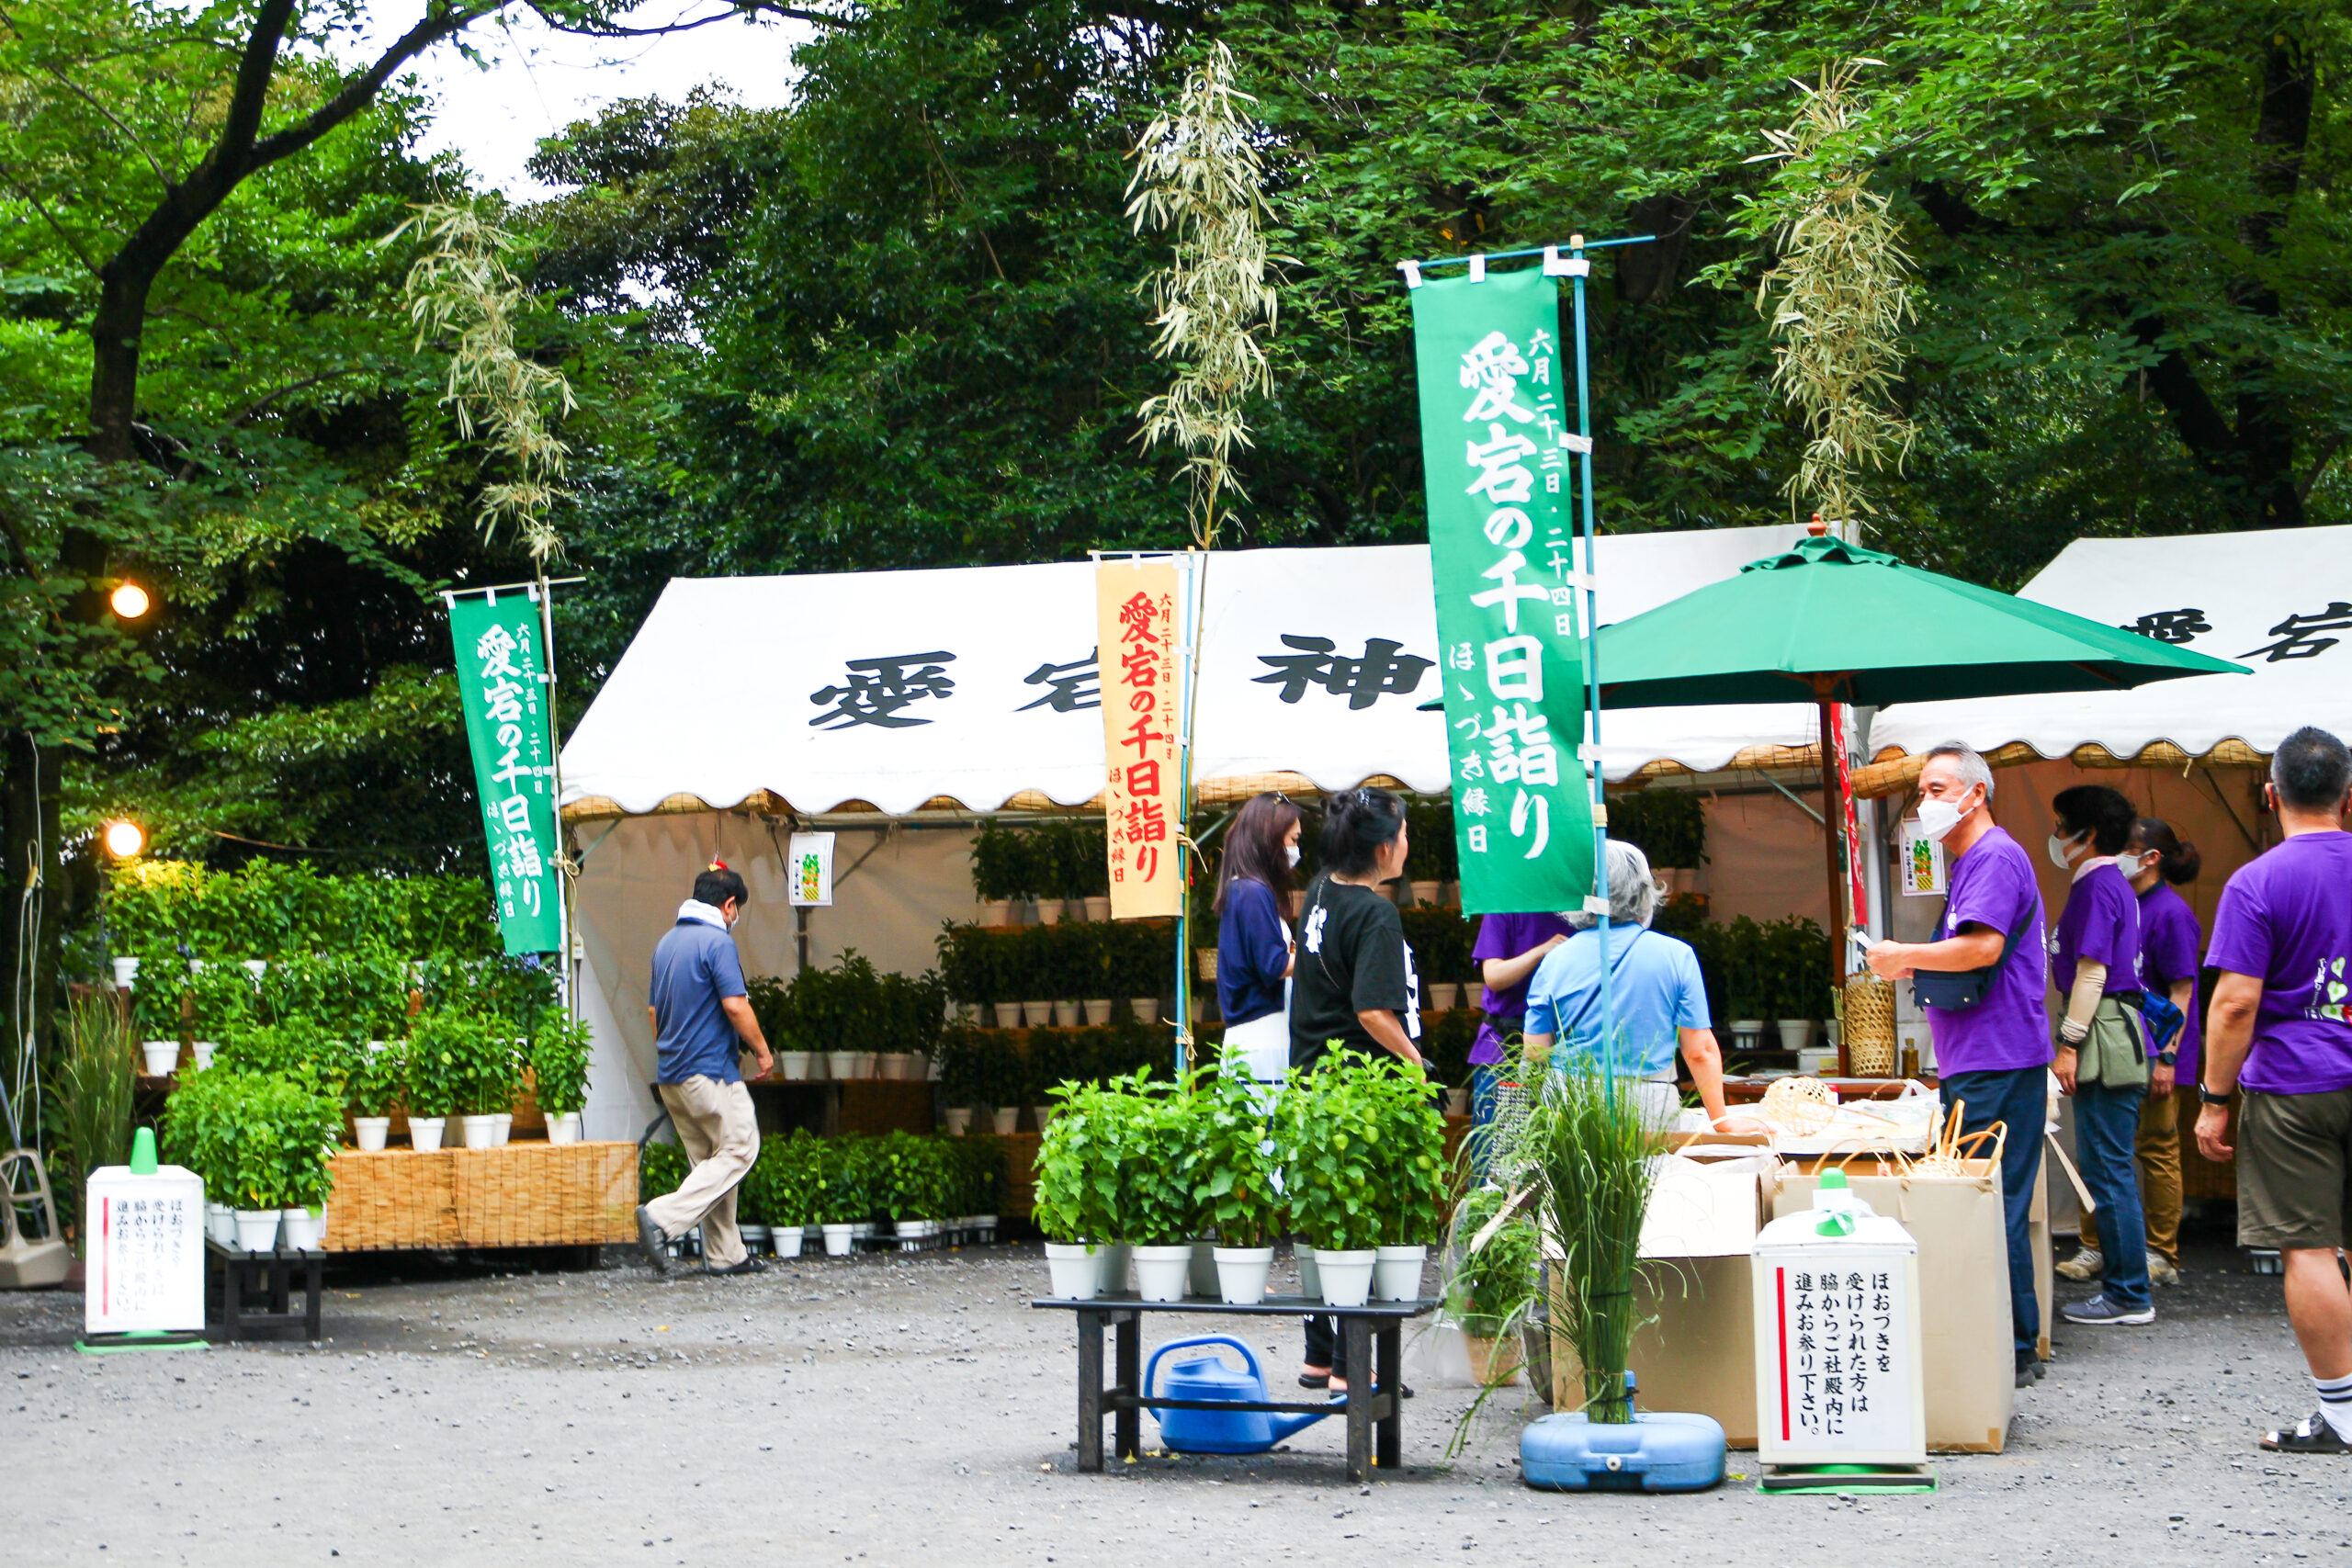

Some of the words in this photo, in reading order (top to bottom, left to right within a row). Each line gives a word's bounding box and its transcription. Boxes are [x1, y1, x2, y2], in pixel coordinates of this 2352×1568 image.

[1459, 331, 1559, 860] 愛宕の千日詣り
[476, 623, 544, 918] 愛宕の千日詣り
[1119, 591, 1167, 883] 愛宕の千日詣り
[1793, 1272, 1820, 1436] 進みお参り下さい。
[1820, 1272, 1845, 1436] 脇からご社殿内に
[1845, 1272, 1869, 1413] 受けられた方は
[1872, 1272, 1891, 1372] ほおづきを
